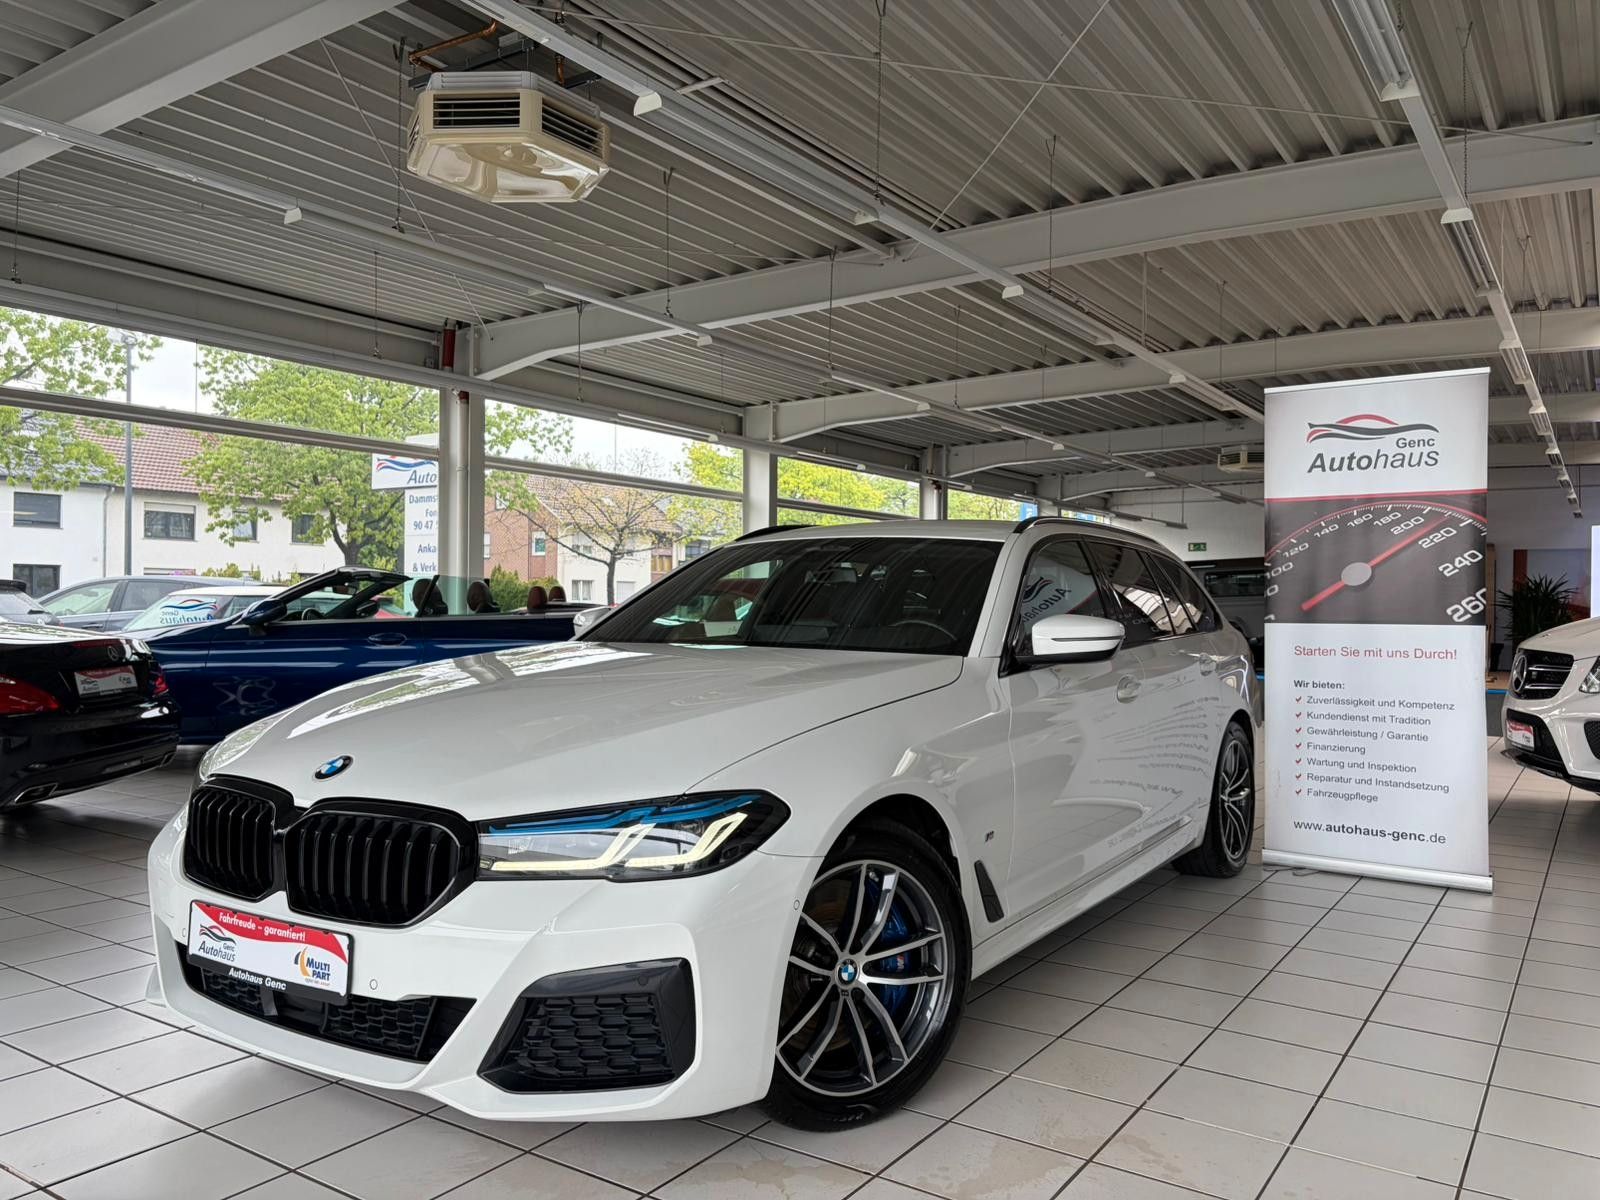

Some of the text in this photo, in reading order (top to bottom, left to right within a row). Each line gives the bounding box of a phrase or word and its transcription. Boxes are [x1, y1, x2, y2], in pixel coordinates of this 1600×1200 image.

[1396, 437, 1435, 449] Genc
[1307, 449, 1439, 474] Autohaus
[409, 495, 438, 504] Damms
[413, 522, 423, 531] 90
[425, 521, 433, 530] 47
[1347, 513, 1373, 528] 160
[1373, 512, 1402, 527] 180
[1390, 516, 1425, 536] 200
[1314, 523, 1340, 538] 140
[1418, 527, 1457, 549] 220
[1282, 542, 1309, 558] 120
[1438, 549, 1484, 578] 240
[1264, 584, 1279, 598] 0
[1294, 645, 1457, 660] Starten Sie mit uns Durch!
[1294, 680, 1345, 690] Wir bieten:
[1307, 696, 1456, 711] Zuverlässigkeit und Kompetenz
[1307, 711, 1431, 726] Kundendienst mit Tradition
[1307, 727, 1378, 740] Gewährleistung
[1387, 731, 1429, 742] Garantie
[1307, 742, 1366, 755] Finanzierung
[1307, 757, 1417, 773] Wartung und Inspektion
[1307, 773, 1450, 793] Reparatur und Instandsetzung
[1307, 788, 1379, 803] Fahrzeugpflege
[1293, 820, 1447, 844] www.autohaus-genc.de
[219, 912, 255, 930] Fahrfreude
[264, 926, 306, 941] garantiert!
[198, 941, 235, 962] Autohaus
[223, 943, 235, 952] Genc
[306, 957, 330, 972] MULTI
[229, 968, 263, 984] Autohaus
[265, 977, 287, 990] Genc
[312, 970, 330, 981] PART
